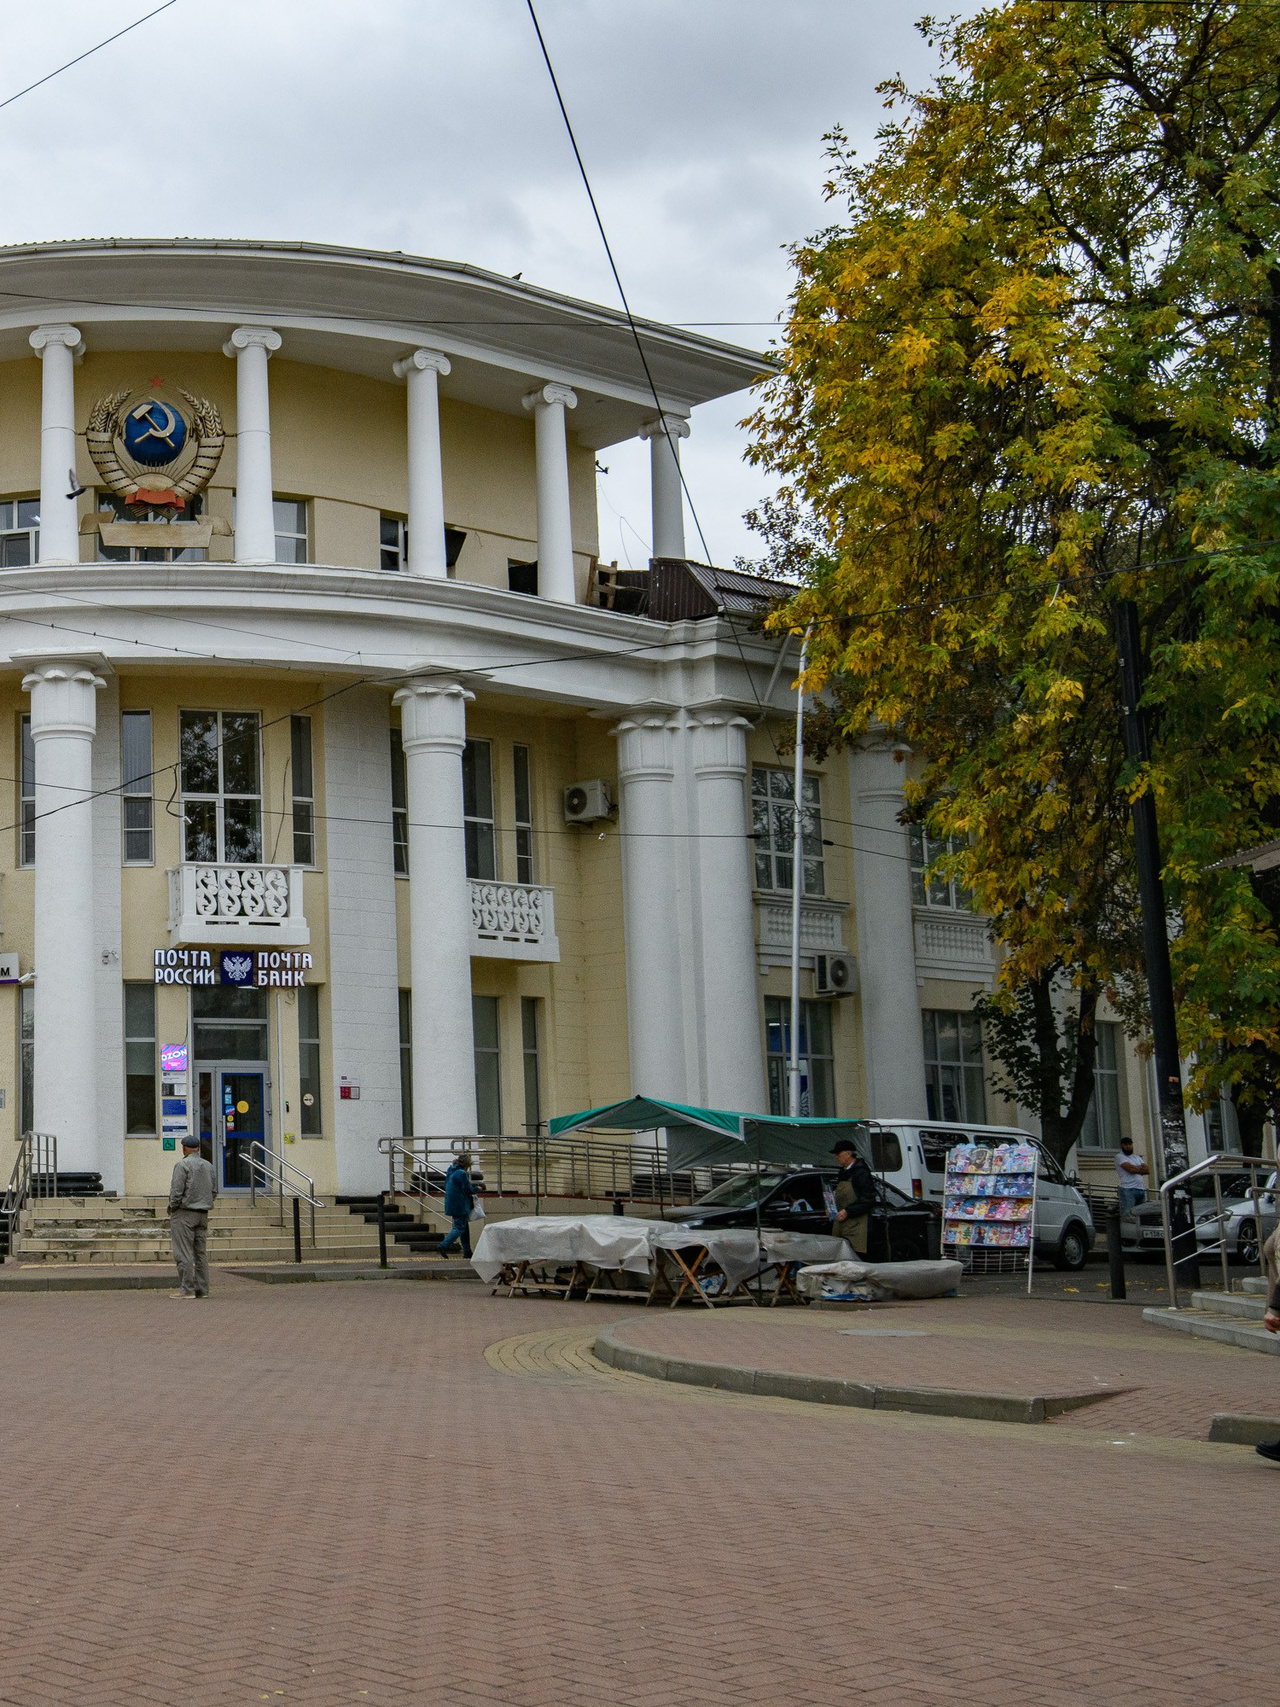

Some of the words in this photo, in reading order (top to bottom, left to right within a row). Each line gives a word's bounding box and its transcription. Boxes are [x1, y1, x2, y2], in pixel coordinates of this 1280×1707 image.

[154, 950, 211, 967] ПОЧТА
[258, 952, 313, 969] ПОЧТА
[154, 968, 215, 985] РОССИИ
[258, 970, 305, 987] БАНК
[161, 1049, 187, 1061] OZON
